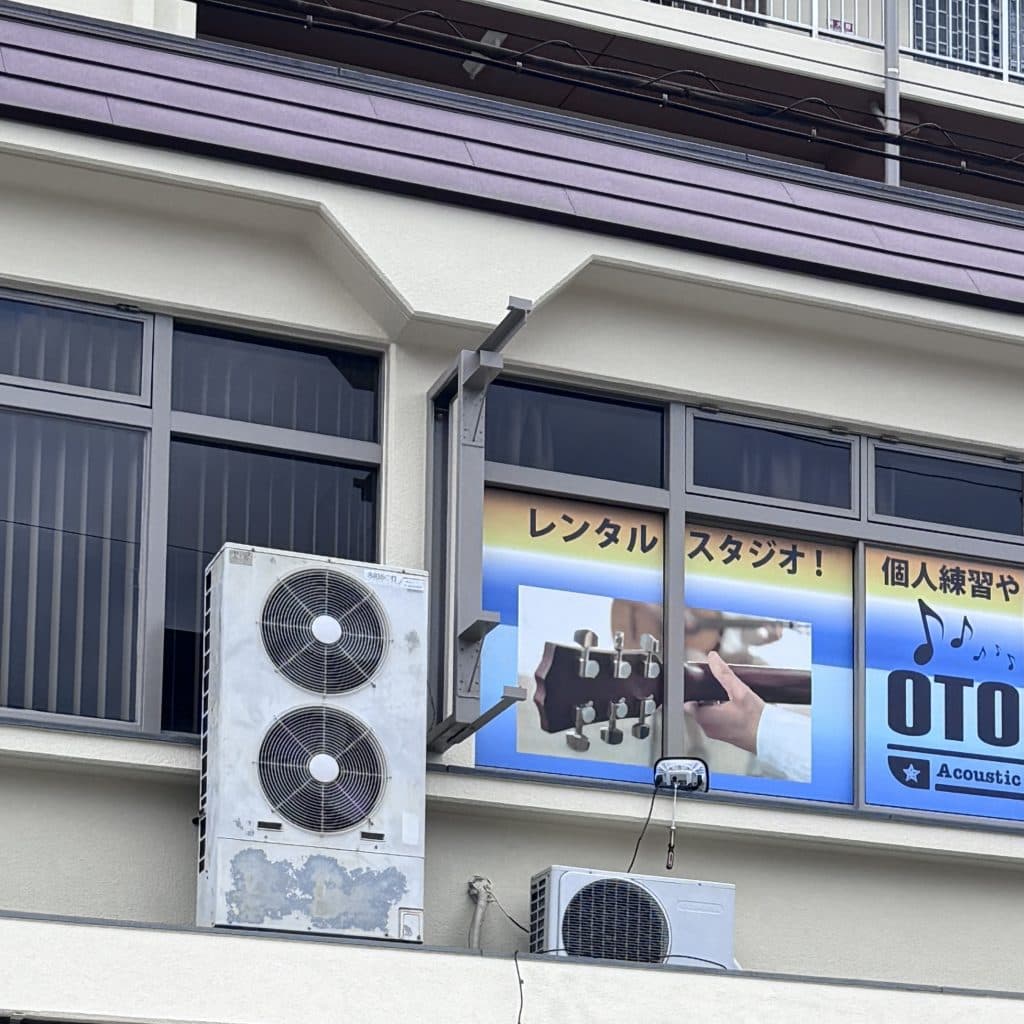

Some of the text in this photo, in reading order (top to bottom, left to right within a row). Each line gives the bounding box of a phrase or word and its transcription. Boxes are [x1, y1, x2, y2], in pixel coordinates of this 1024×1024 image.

[529, 508, 658, 553] レンタル
[881, 556, 1020, 602] 個人練習や
[887, 669, 1020, 747] OTO
[936, 763, 1022, 787] Acoustic
